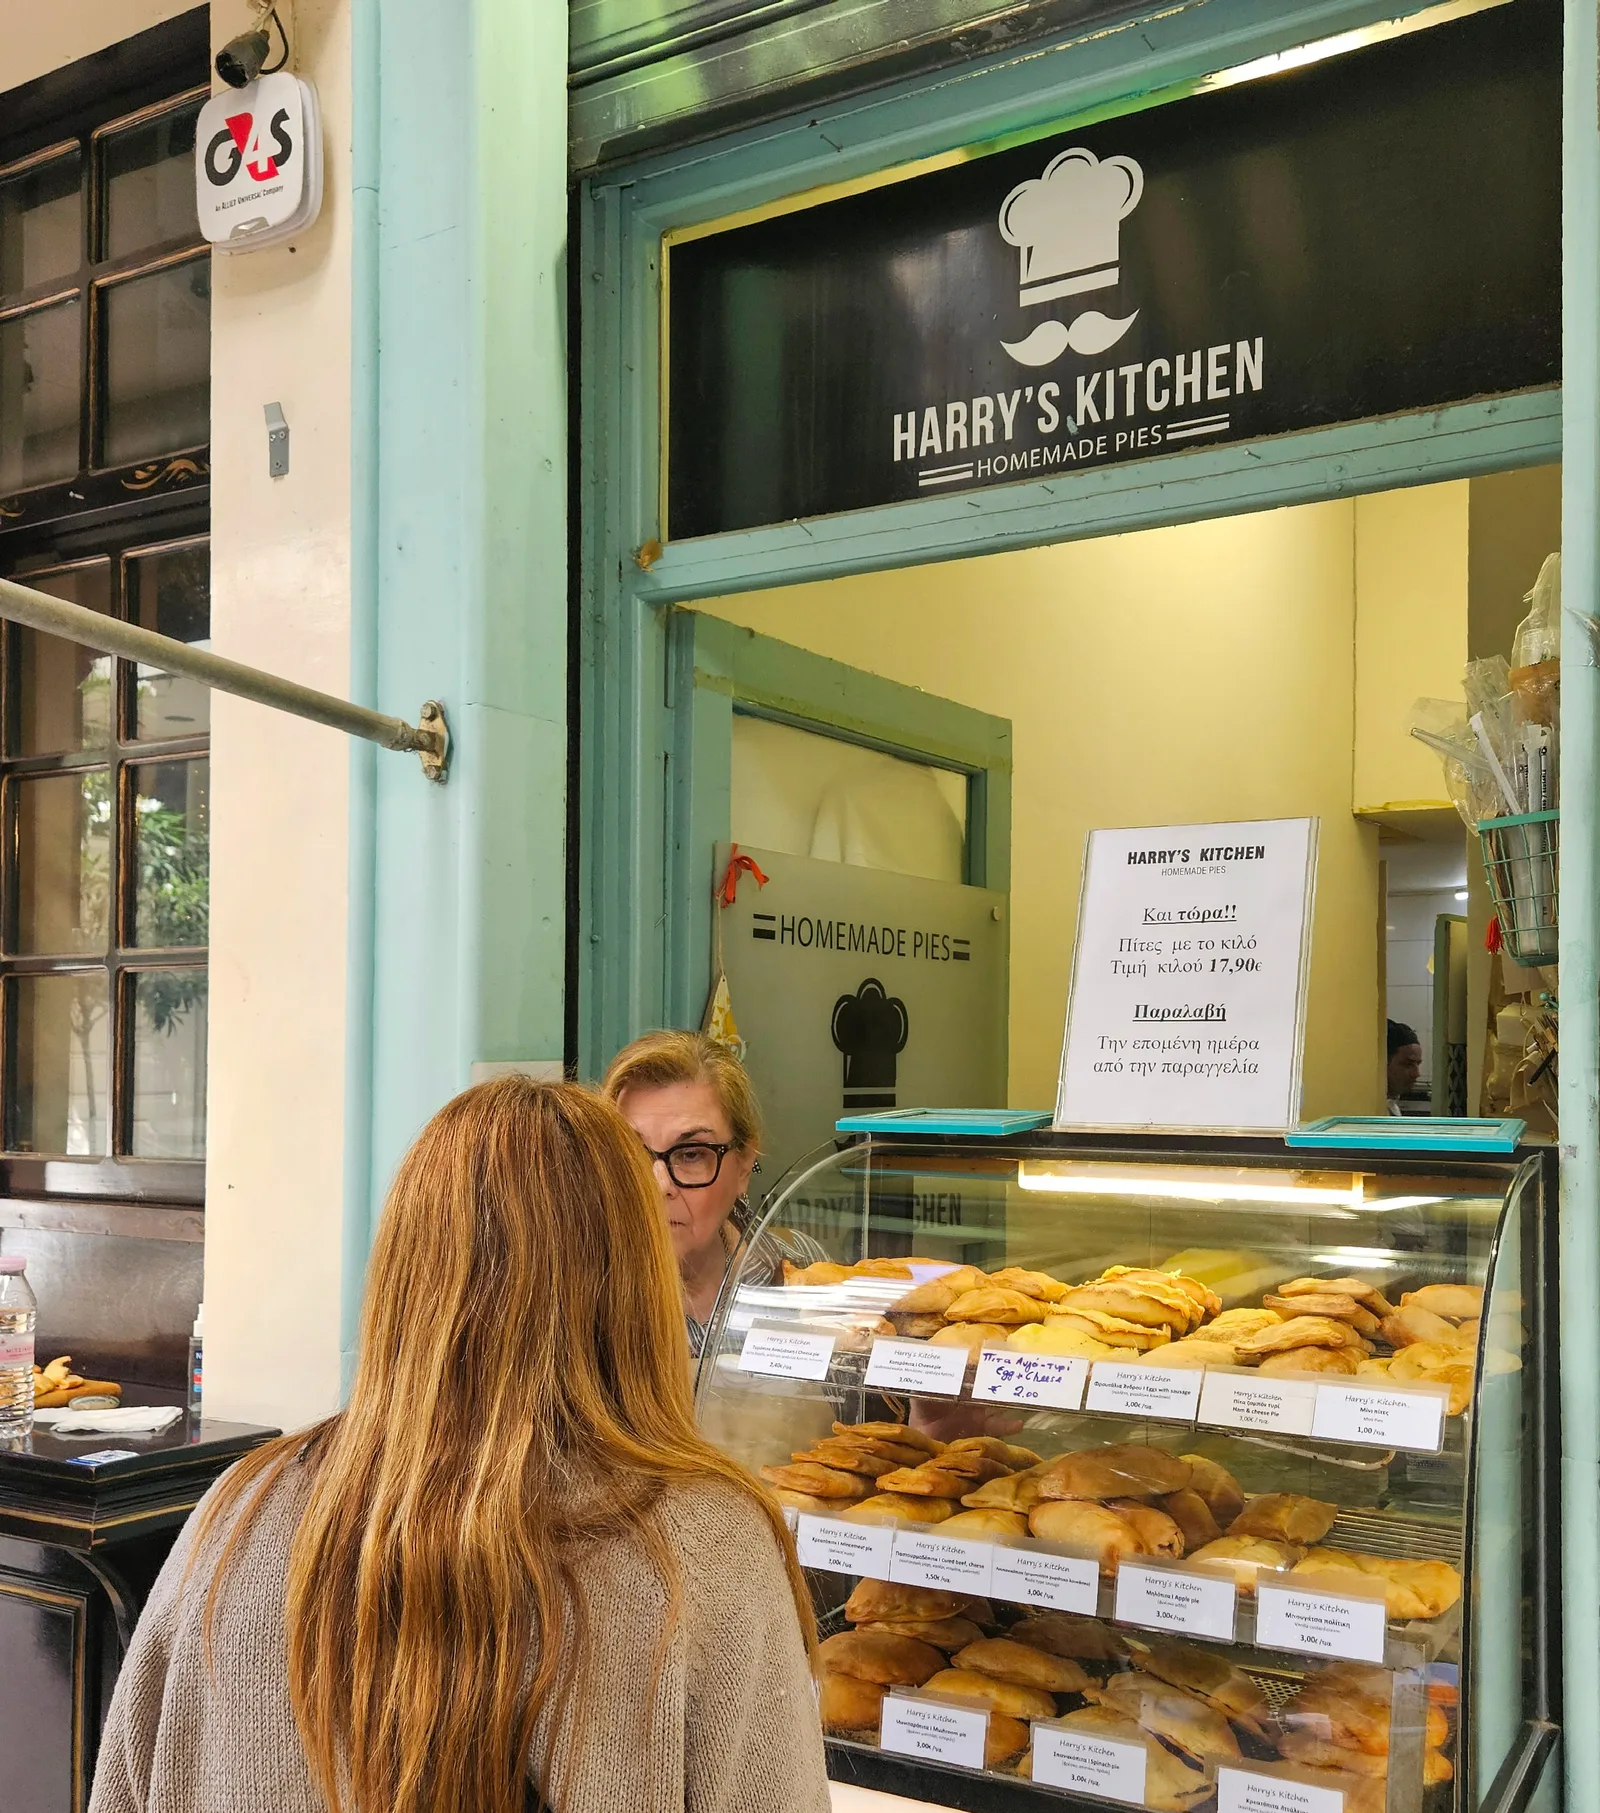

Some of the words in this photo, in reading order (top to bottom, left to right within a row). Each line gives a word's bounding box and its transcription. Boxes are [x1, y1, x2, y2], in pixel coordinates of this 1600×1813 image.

[205, 108, 292, 186] G4S
[893, 382, 1060, 461] HARRY'S
[1076, 336, 1263, 426] KITCHEN
[978, 435, 1108, 478] HOMEMADE
[1115, 425, 1162, 452] PIES
[1127, 849, 1190, 865] HARRY'S
[1200, 846, 1265, 862] KITCHEN
[1161, 866, 1206, 877] HOMEMADE
[1208, 865, 1226, 875] PIES
[1143, 907, 1172, 922] Και
[1177, 905, 1237, 923] τώρα!!
[781, 915, 906, 957] HOMEMADE
[913, 931, 950, 962] PIES
[1119, 937, 1162, 955] Πίτες
[1172, 939, 1191, 955] με
[1197, 940, 1215, 950] το
[1221, 934, 1257, 950] κιλό
[1111, 959, 1147, 978] Τιμή
[1158, 958, 1202, 973] κιλού
[1209, 958, 1263, 975] 17,90€
[1133, 1003, 1226, 1022] Παραλαβή
[1098, 1035, 1127, 1053] Την
[1132, 1035, 1201, 1054] επομένη
[1207, 1035, 1259, 1053] ημέρα
[1094, 1058, 1123, 1073] από
[1129, 1061, 1156, 1076] την
[1162, 1058, 1259, 1077] παραγγελία
[996, 1366, 1015, 1381] Egg
[1026, 1371, 1062, 1383] Cheese
[1117, 1372, 1142, 1381] Harry's
[1144, 1374, 1171, 1382] Kitchen
[1345, 1394, 1374, 1405] Harry's
[1357, 1426, 1373, 1434] 1,00
[820, 1528, 842, 1538] Harry's
[844, 1531, 867, 1541] Kitchen
[865, 1544, 873, 1552] pie
[916, 1542, 939, 1552] Harry's
[941, 1545, 965, 1554] Kitchen
[1017, 1558, 1042, 1569] Harry's
[1044, 1562, 1070, 1572] Kitchen
[1145, 1576, 1172, 1588] Harry's
[1174, 1581, 1202, 1592] Kitchen
[1175, 1595, 1190, 1603] Apple
[1288, 1598, 1317, 1610] Harry's
[1319, 1603, 1349, 1615] Kitchen
[906, 1709, 931, 1720] Harry's
[933, 1713, 957, 1724] Kitchen
[933, 1727, 958, 1736] Mushroom
[1059, 1740, 1086, 1752] Harry's
[1088, 1745, 1115, 1757] Kitchen
[1090, 1759, 1111, 1768] Spinach
[1247, 1784, 1276, 1797] Harry's
[1279, 1791, 1309, 1803] Kitchen
